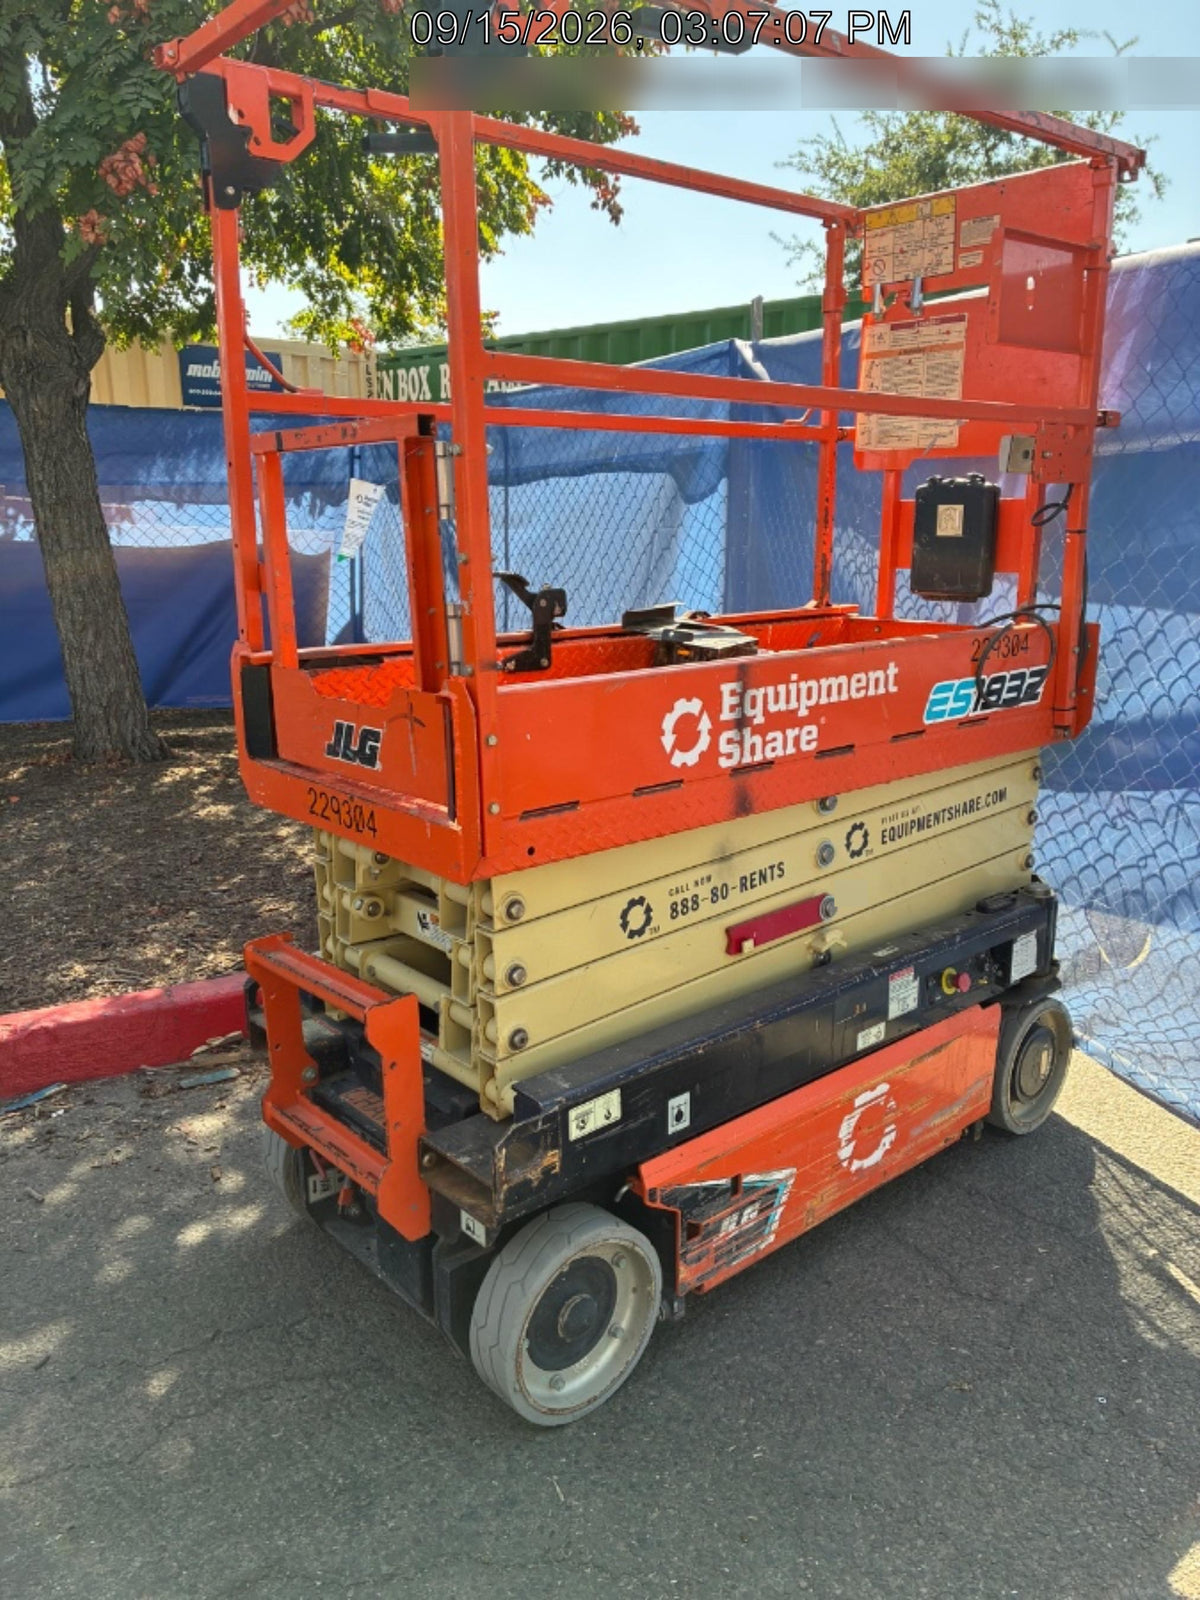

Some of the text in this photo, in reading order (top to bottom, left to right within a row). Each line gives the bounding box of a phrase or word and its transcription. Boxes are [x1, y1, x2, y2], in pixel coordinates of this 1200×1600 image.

[396, 364, 432, 402] BOX
[719, 661, 899, 726] Equipment
[325, 719, 383, 771] JLG
[718, 724, 819, 770] Share
[306, 786, 378, 838] 229304
[881, 787, 1008, 845] EQUIPMENTSHARE.COM
[669, 861, 786, 920] 888-80-RENTS
